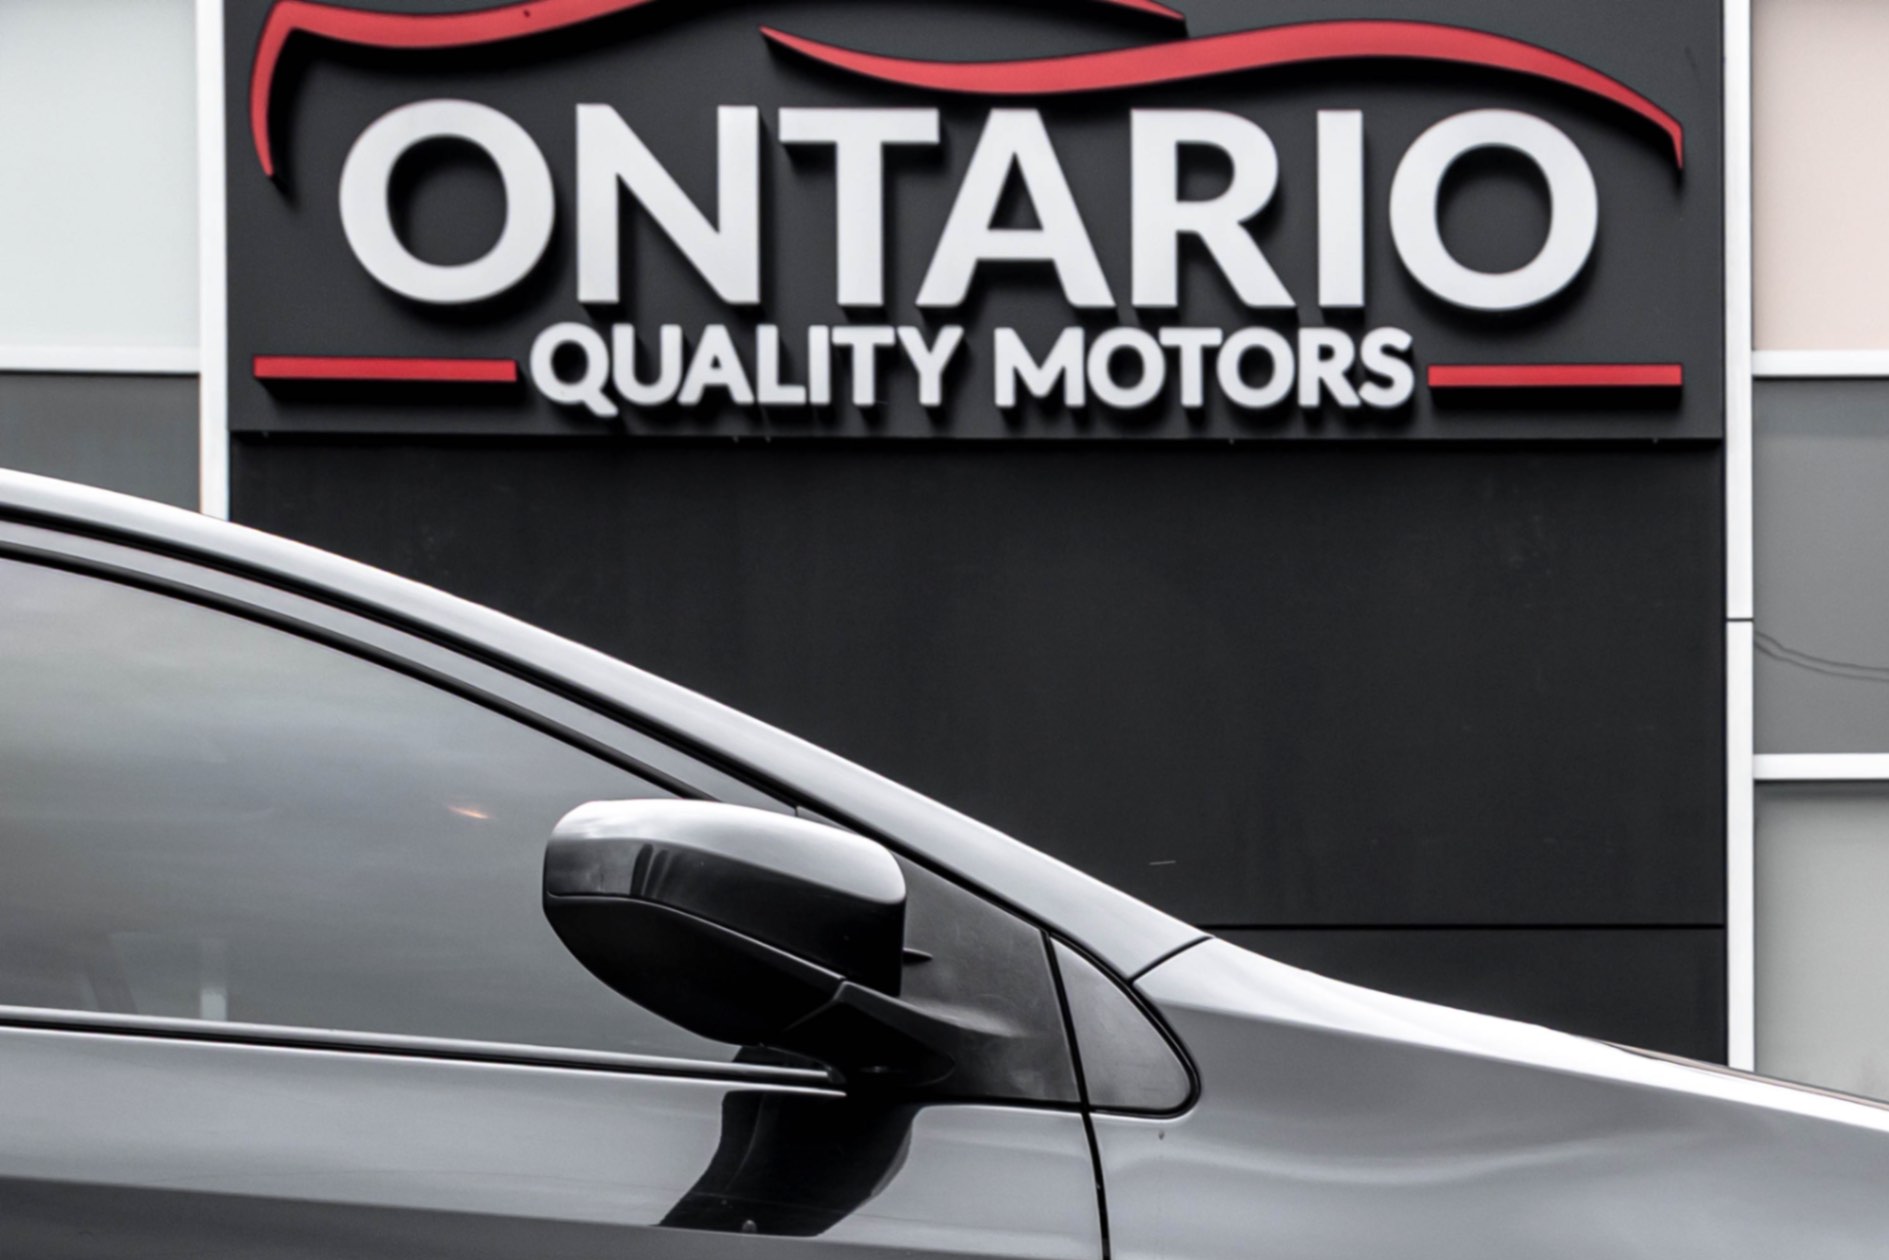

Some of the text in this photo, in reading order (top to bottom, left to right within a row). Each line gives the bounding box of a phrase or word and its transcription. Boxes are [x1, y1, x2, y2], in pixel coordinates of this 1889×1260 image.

[339, 99, 1598, 310] ONTARIO
[530, 322, 1414, 416] QUALITY MOTORS
